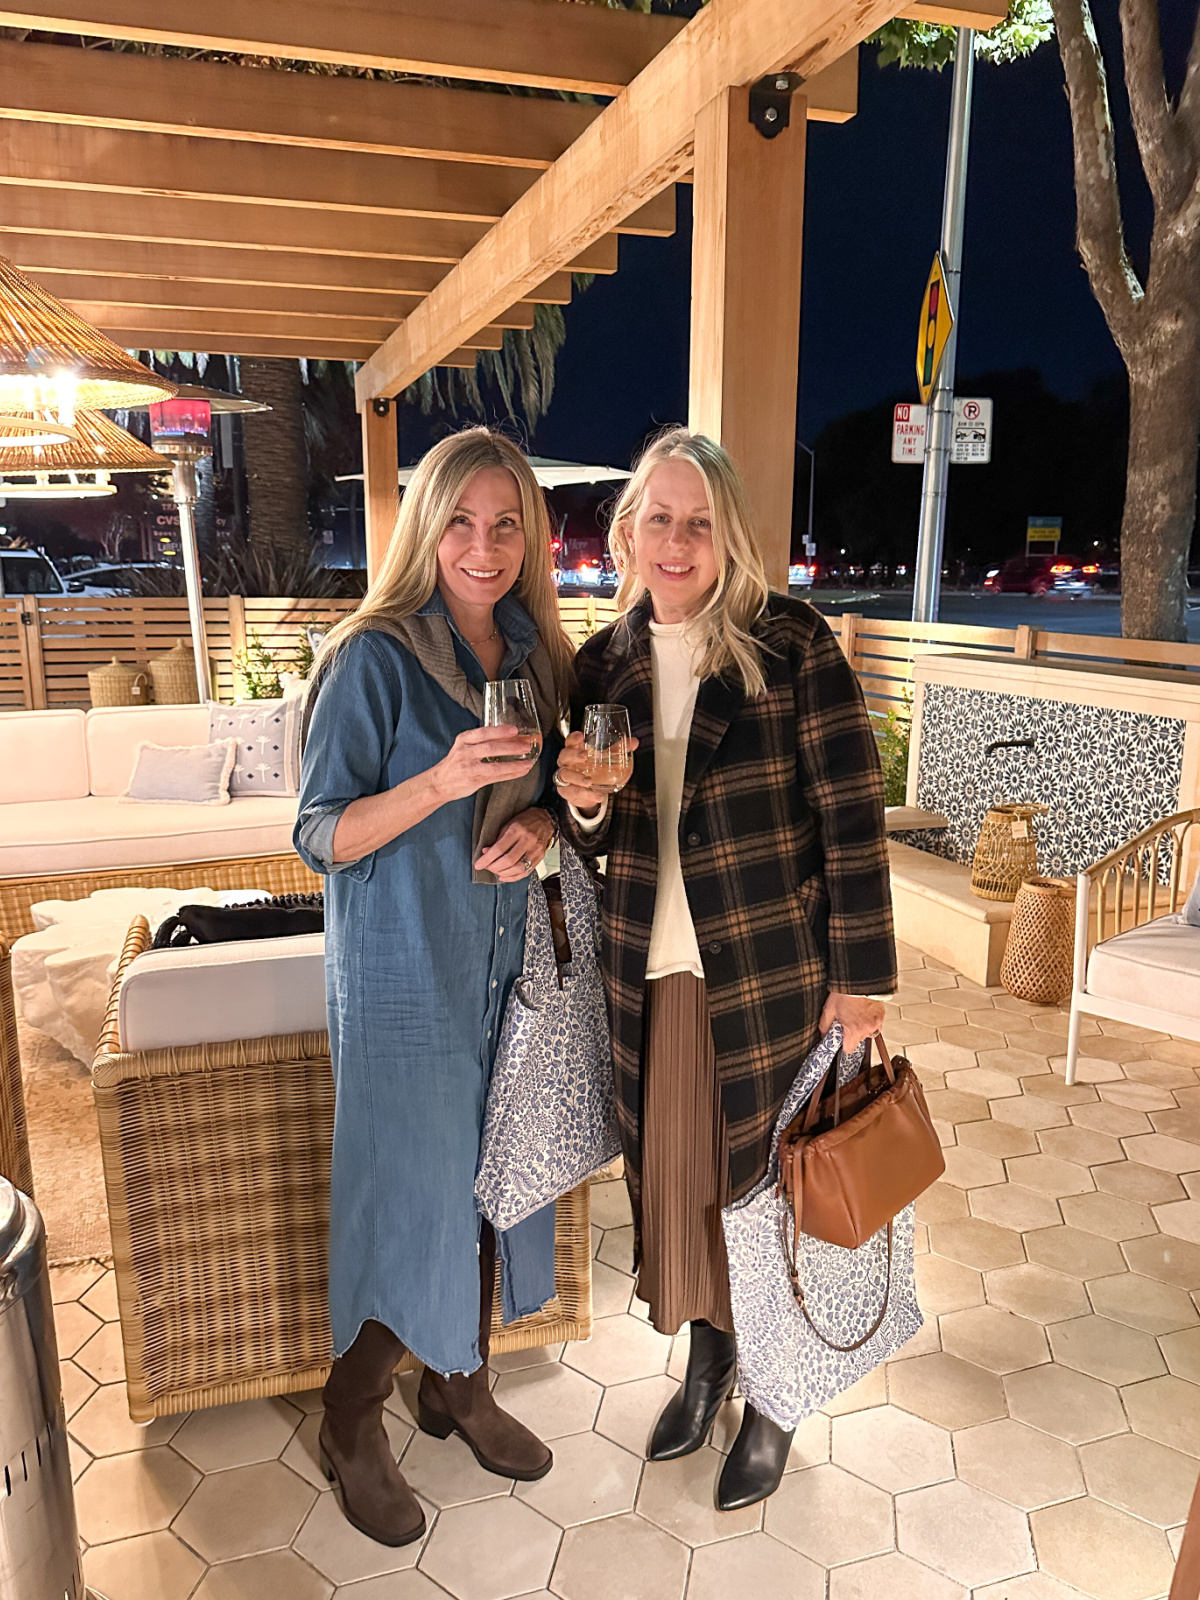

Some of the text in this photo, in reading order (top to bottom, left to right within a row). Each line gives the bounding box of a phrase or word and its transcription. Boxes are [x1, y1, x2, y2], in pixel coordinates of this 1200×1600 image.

[896, 406, 909, 420] NO
[896, 424, 925, 436] PARKING
[903, 437, 917, 445] ANY
[902, 447, 917, 456] TIME
[156, 515, 180, 526] CVS
